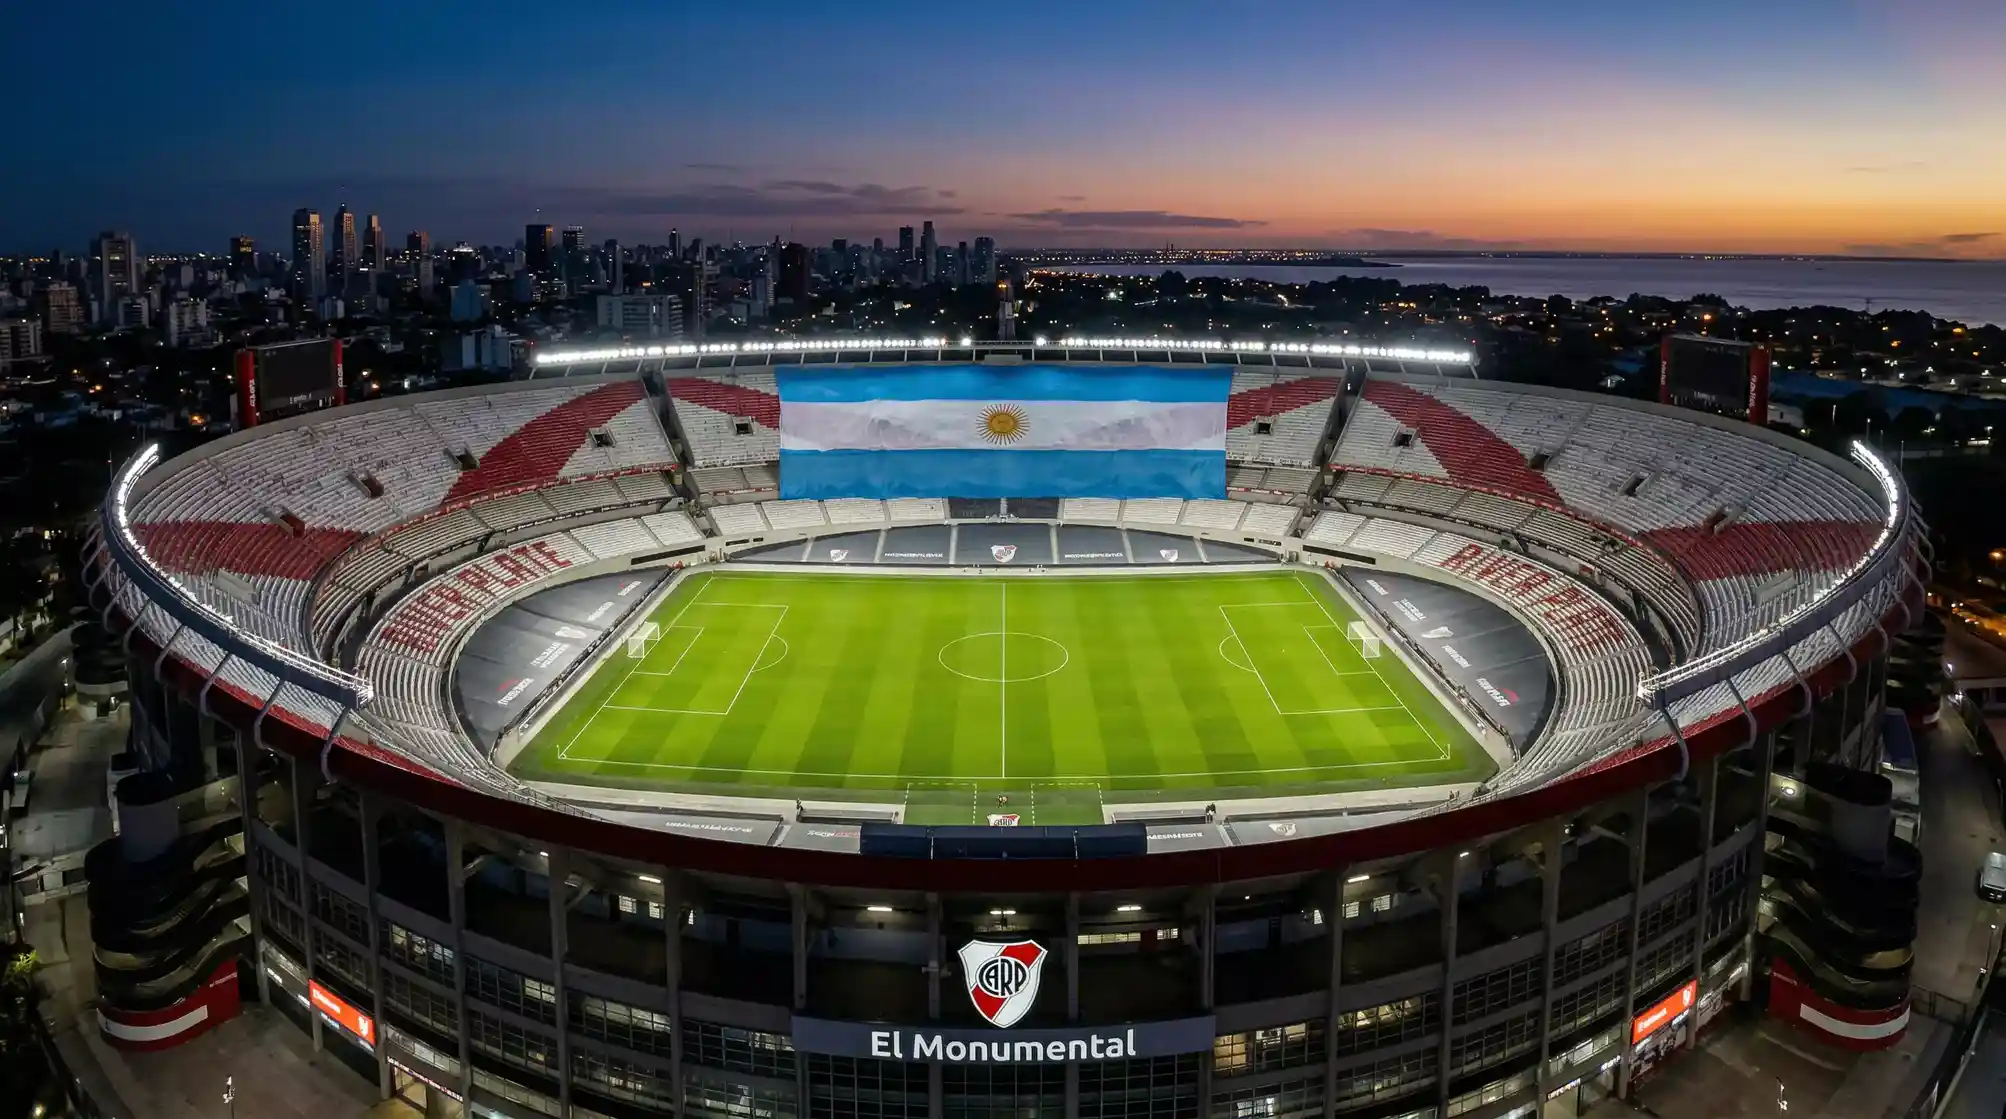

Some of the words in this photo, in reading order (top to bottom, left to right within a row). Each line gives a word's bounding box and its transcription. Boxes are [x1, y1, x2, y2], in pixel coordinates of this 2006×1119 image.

[456, 541, 573, 597] PLATE
[978, 958, 1027, 996] CARP
[871, 1031, 903, 1059] El
[913, 1029, 1137, 1061] Monumental
